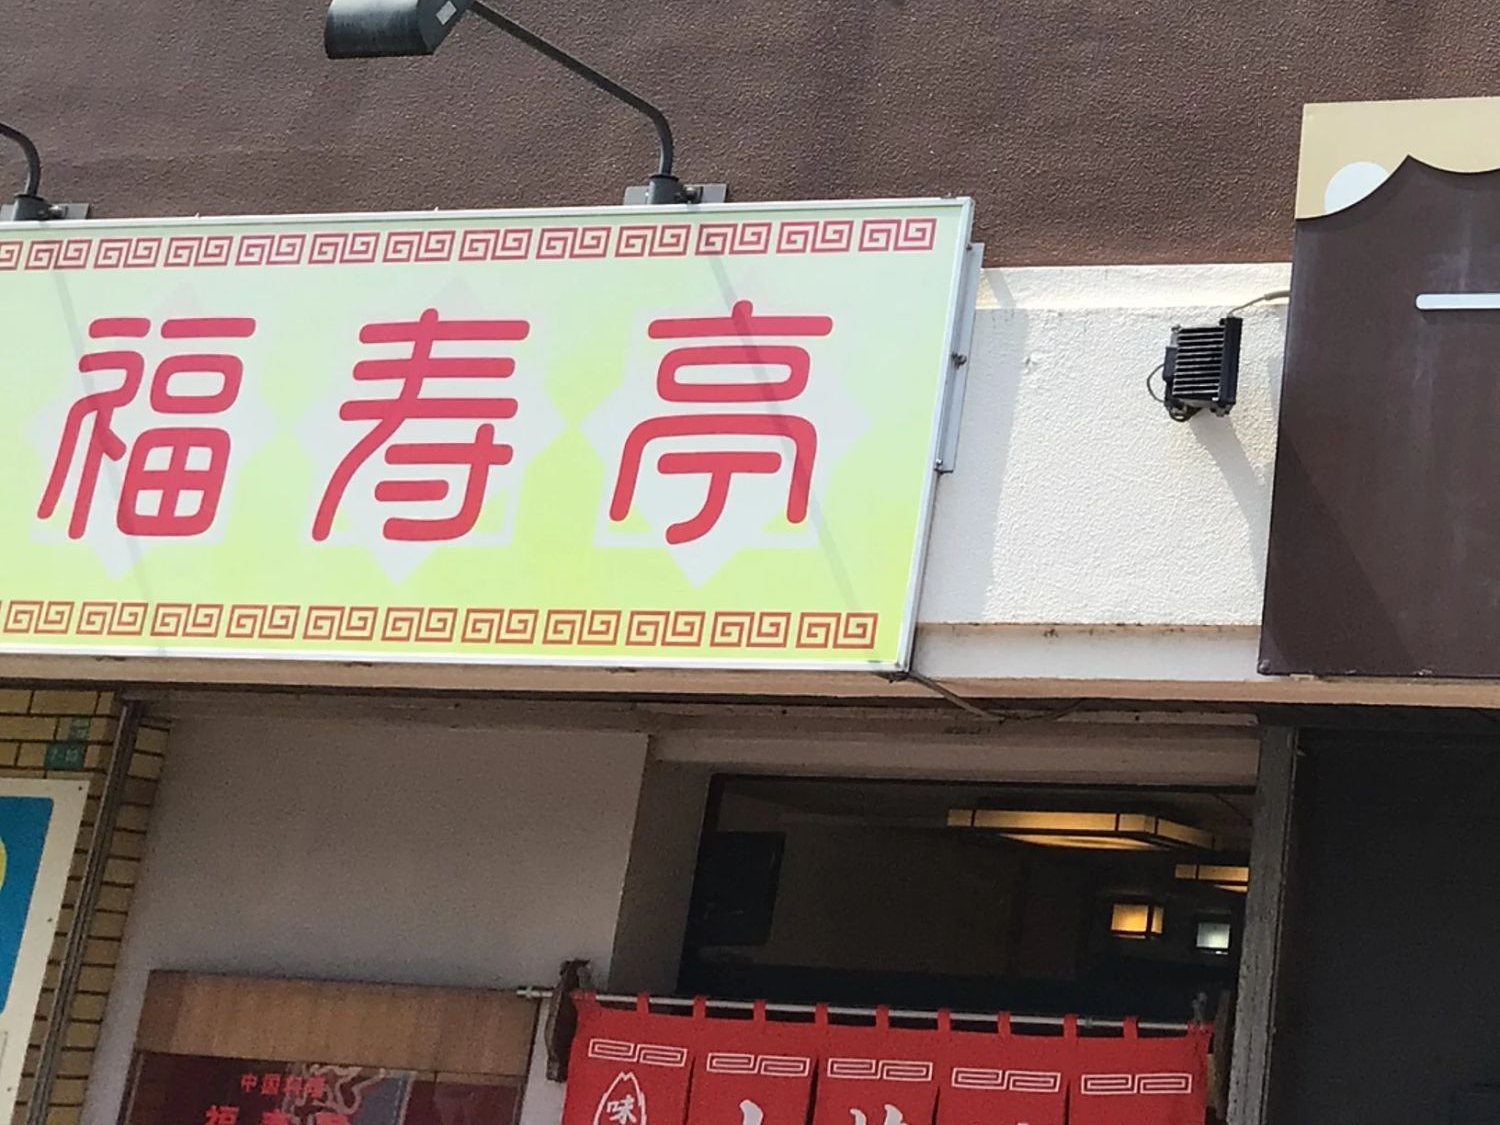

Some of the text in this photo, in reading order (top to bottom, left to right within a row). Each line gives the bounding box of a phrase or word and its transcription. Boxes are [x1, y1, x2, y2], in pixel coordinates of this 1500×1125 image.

[37, 300, 833, 545] 福寿亭
[606, 1093, 637, 1125] 味
